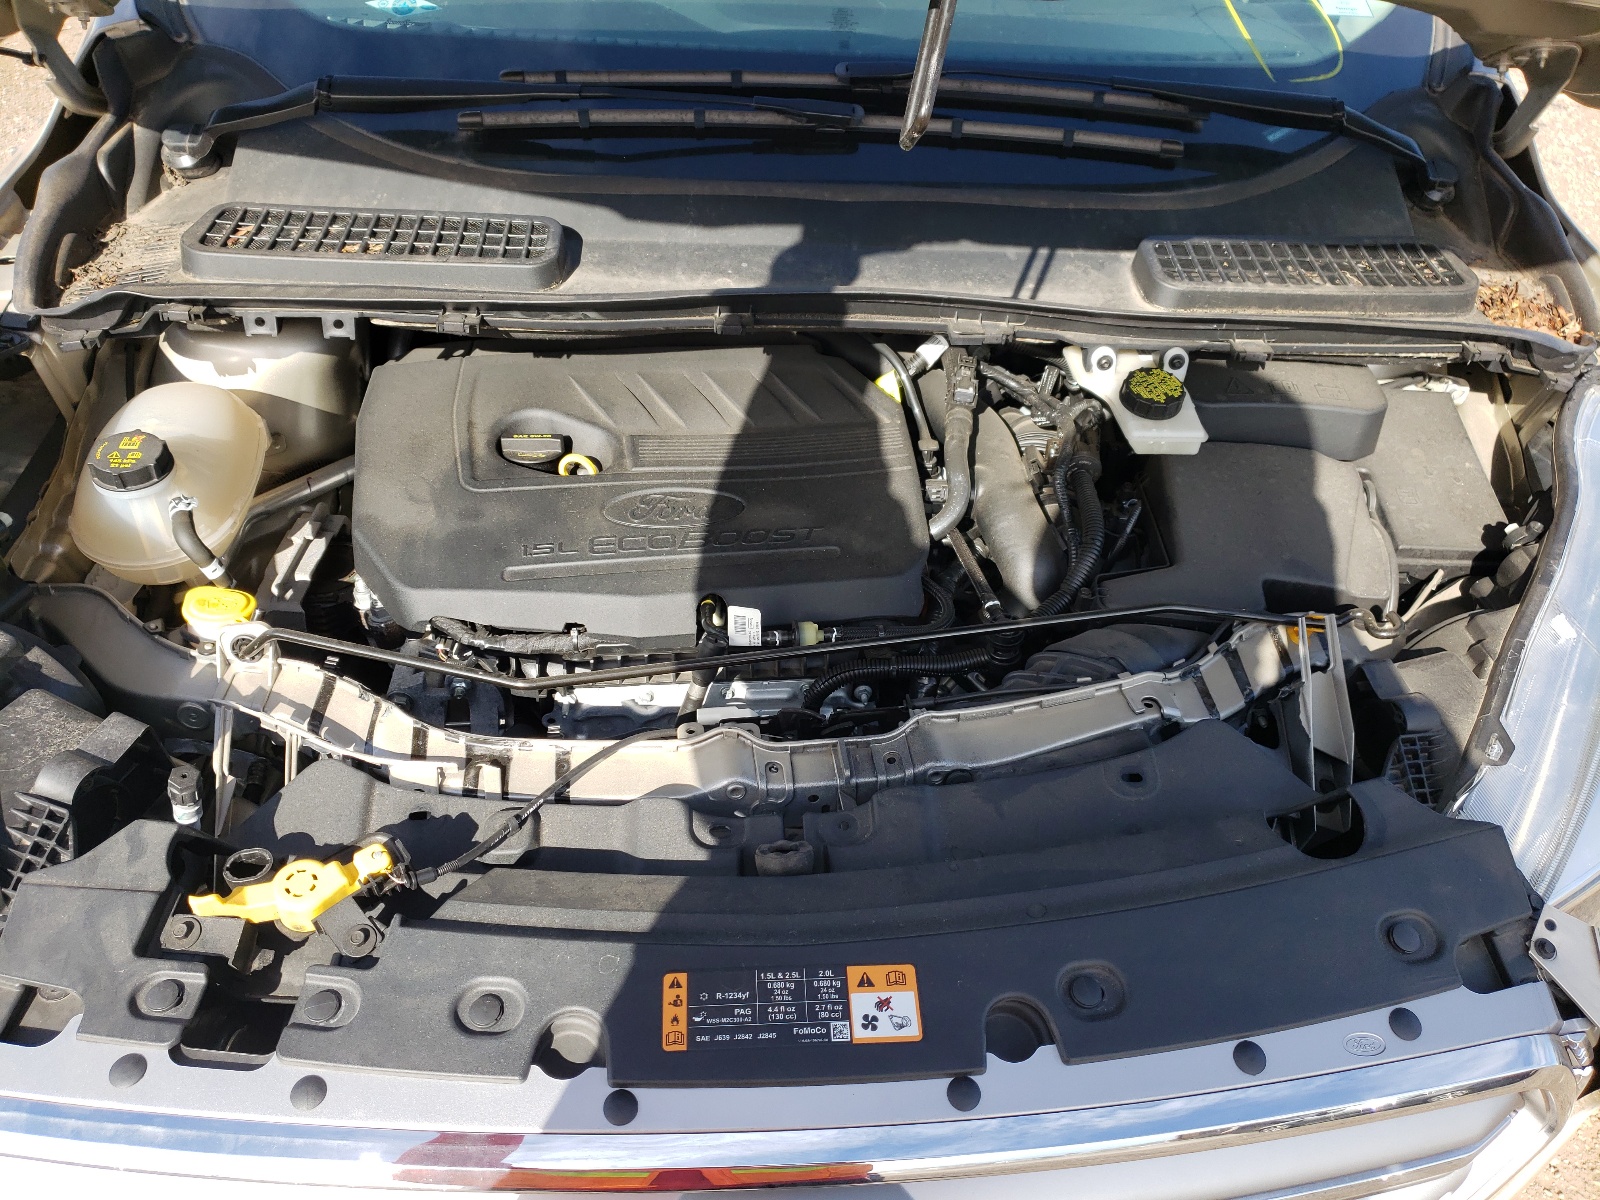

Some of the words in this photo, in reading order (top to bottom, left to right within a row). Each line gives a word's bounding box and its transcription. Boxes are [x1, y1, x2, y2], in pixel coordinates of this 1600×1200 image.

[588, 527, 825, 556] ECOBOOST
[785, 971, 801, 979] 2.5L
[832, 980, 841, 988] kg
[716, 991, 750, 1000] R-1234yf
[734, 1008, 752, 1016] PAG
[818, 1011, 829, 1019] (80
[768, 1013, 784, 1021] (130
[793, 1026, 827, 1035] FoMoCo
